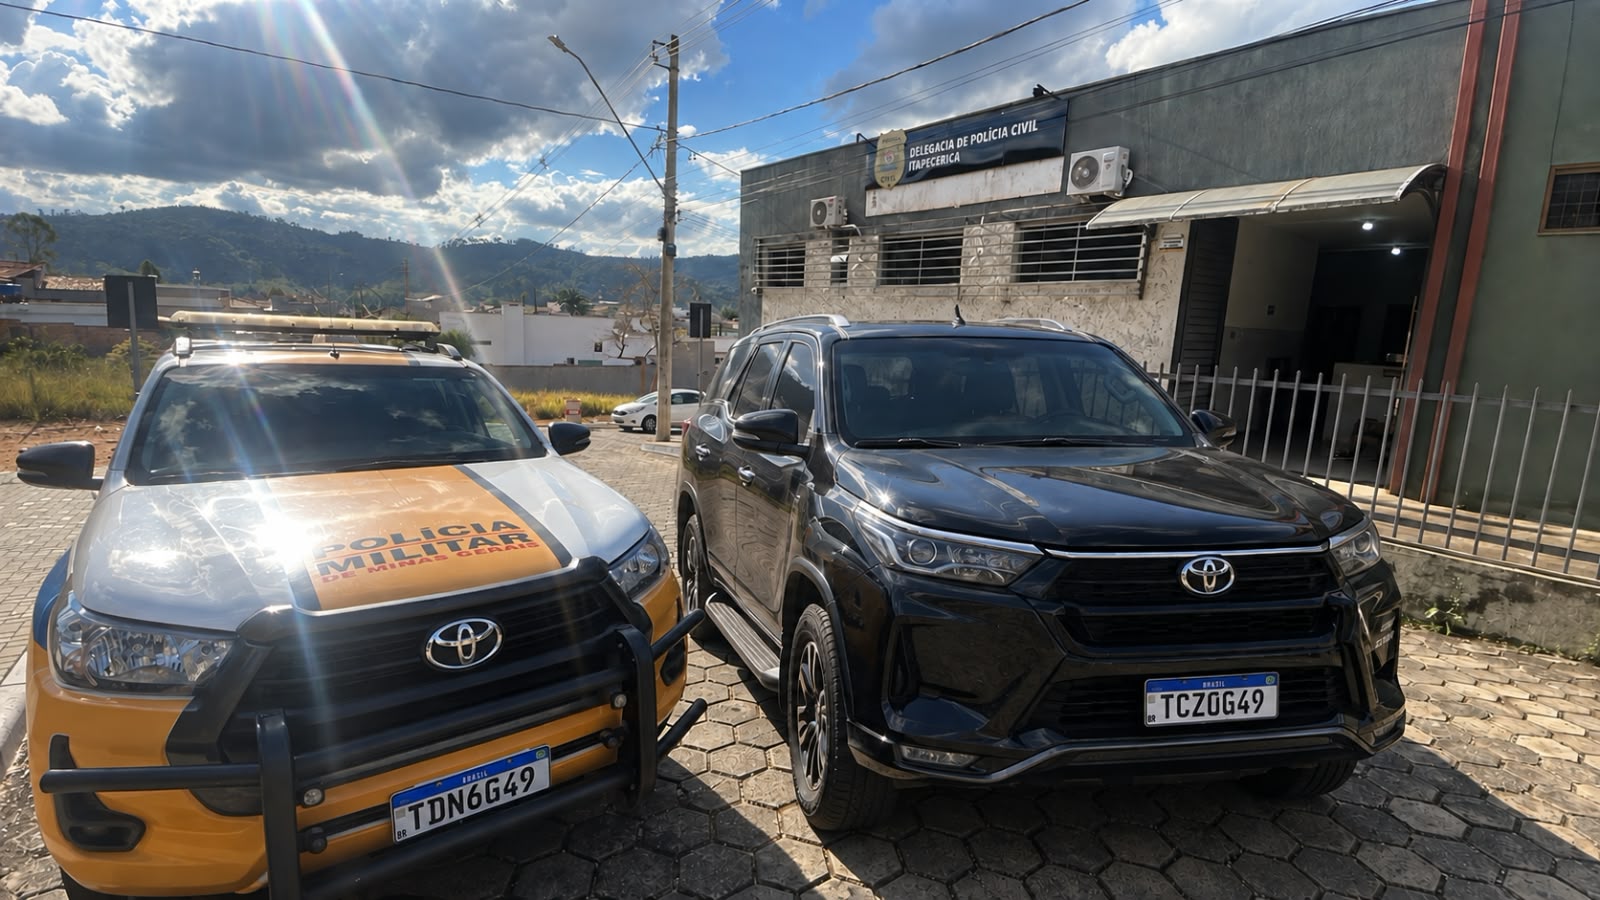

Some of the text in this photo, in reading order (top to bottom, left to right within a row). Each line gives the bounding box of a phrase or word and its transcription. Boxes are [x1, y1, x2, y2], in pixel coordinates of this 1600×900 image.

[909, 138, 955, 158] DELEGACIA
[956, 135, 970, 148] DE
[970, 127, 1008, 145] POLÍCIA
[1011, 119, 1038, 136] CIVIL
[908, 152, 960, 172] ITAPECERICA
[316, 533, 533, 576] MILITAR
[321, 541, 541, 583] DE MINAS GERAIS
[1202, 680, 1225, 688] BRASIL
[462, 770, 488, 784] BRASIL
[408, 766, 535, 830] TDN6G49
[397, 829, 408, 840] BR
